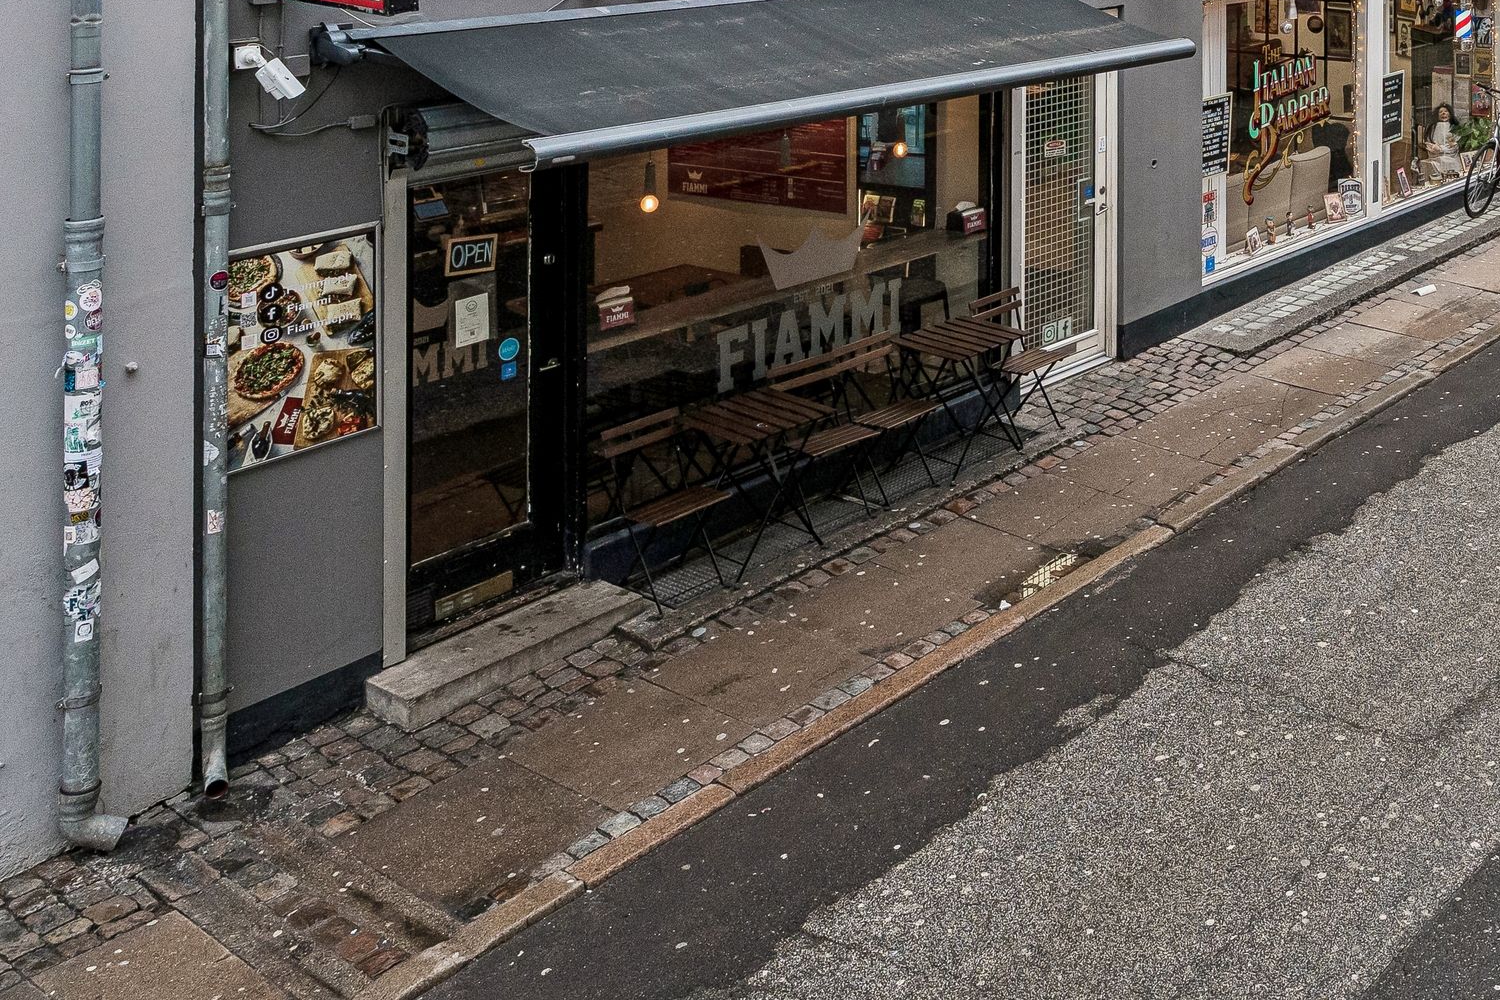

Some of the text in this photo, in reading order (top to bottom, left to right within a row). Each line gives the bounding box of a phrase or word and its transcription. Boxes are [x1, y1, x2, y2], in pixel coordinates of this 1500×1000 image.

[1253, 54, 1317, 101] ITALIAN
[1249, 86, 1331, 145] BARBER
[682, 181, 708, 195] FIAMMI
[451, 241, 493, 269] OPEN
[286, 294, 332, 314] Fiammi
[606, 311, 629, 323] FIAMMI
[286, 312, 354, 336] Fiammicph
[716, 277, 902, 394] FIAMMI
